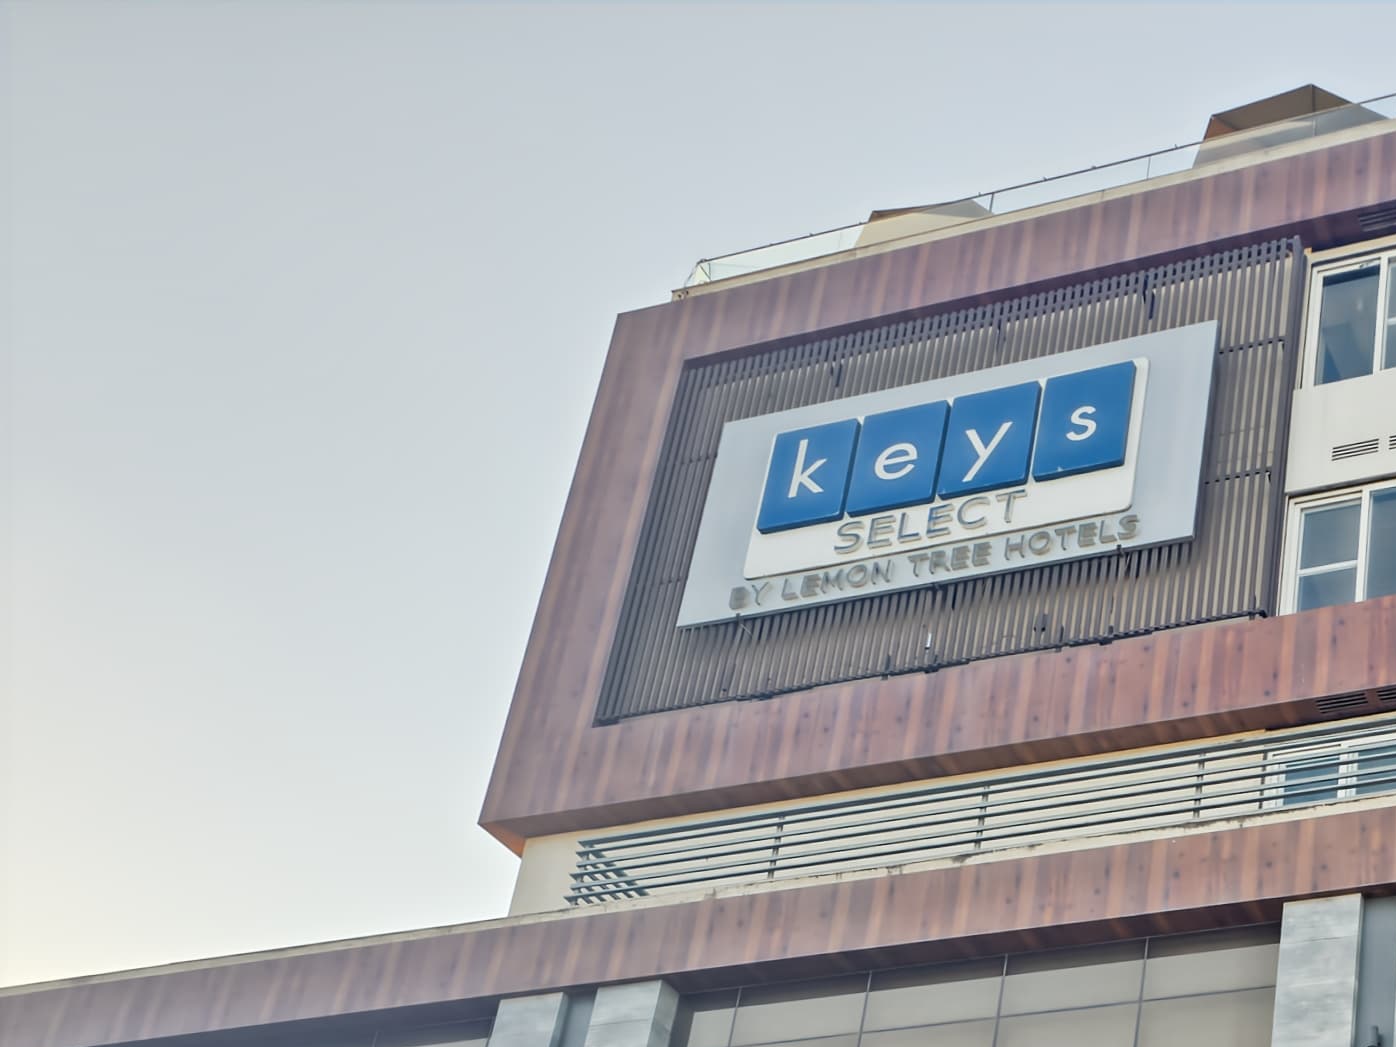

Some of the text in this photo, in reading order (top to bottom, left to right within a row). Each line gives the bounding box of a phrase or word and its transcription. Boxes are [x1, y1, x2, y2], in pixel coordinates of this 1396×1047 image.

[788, 405, 1098, 499] keys
[729, 514, 1140, 610] BY LEMON TREE HOTELS
[834, 489, 1027, 555] SELECT
